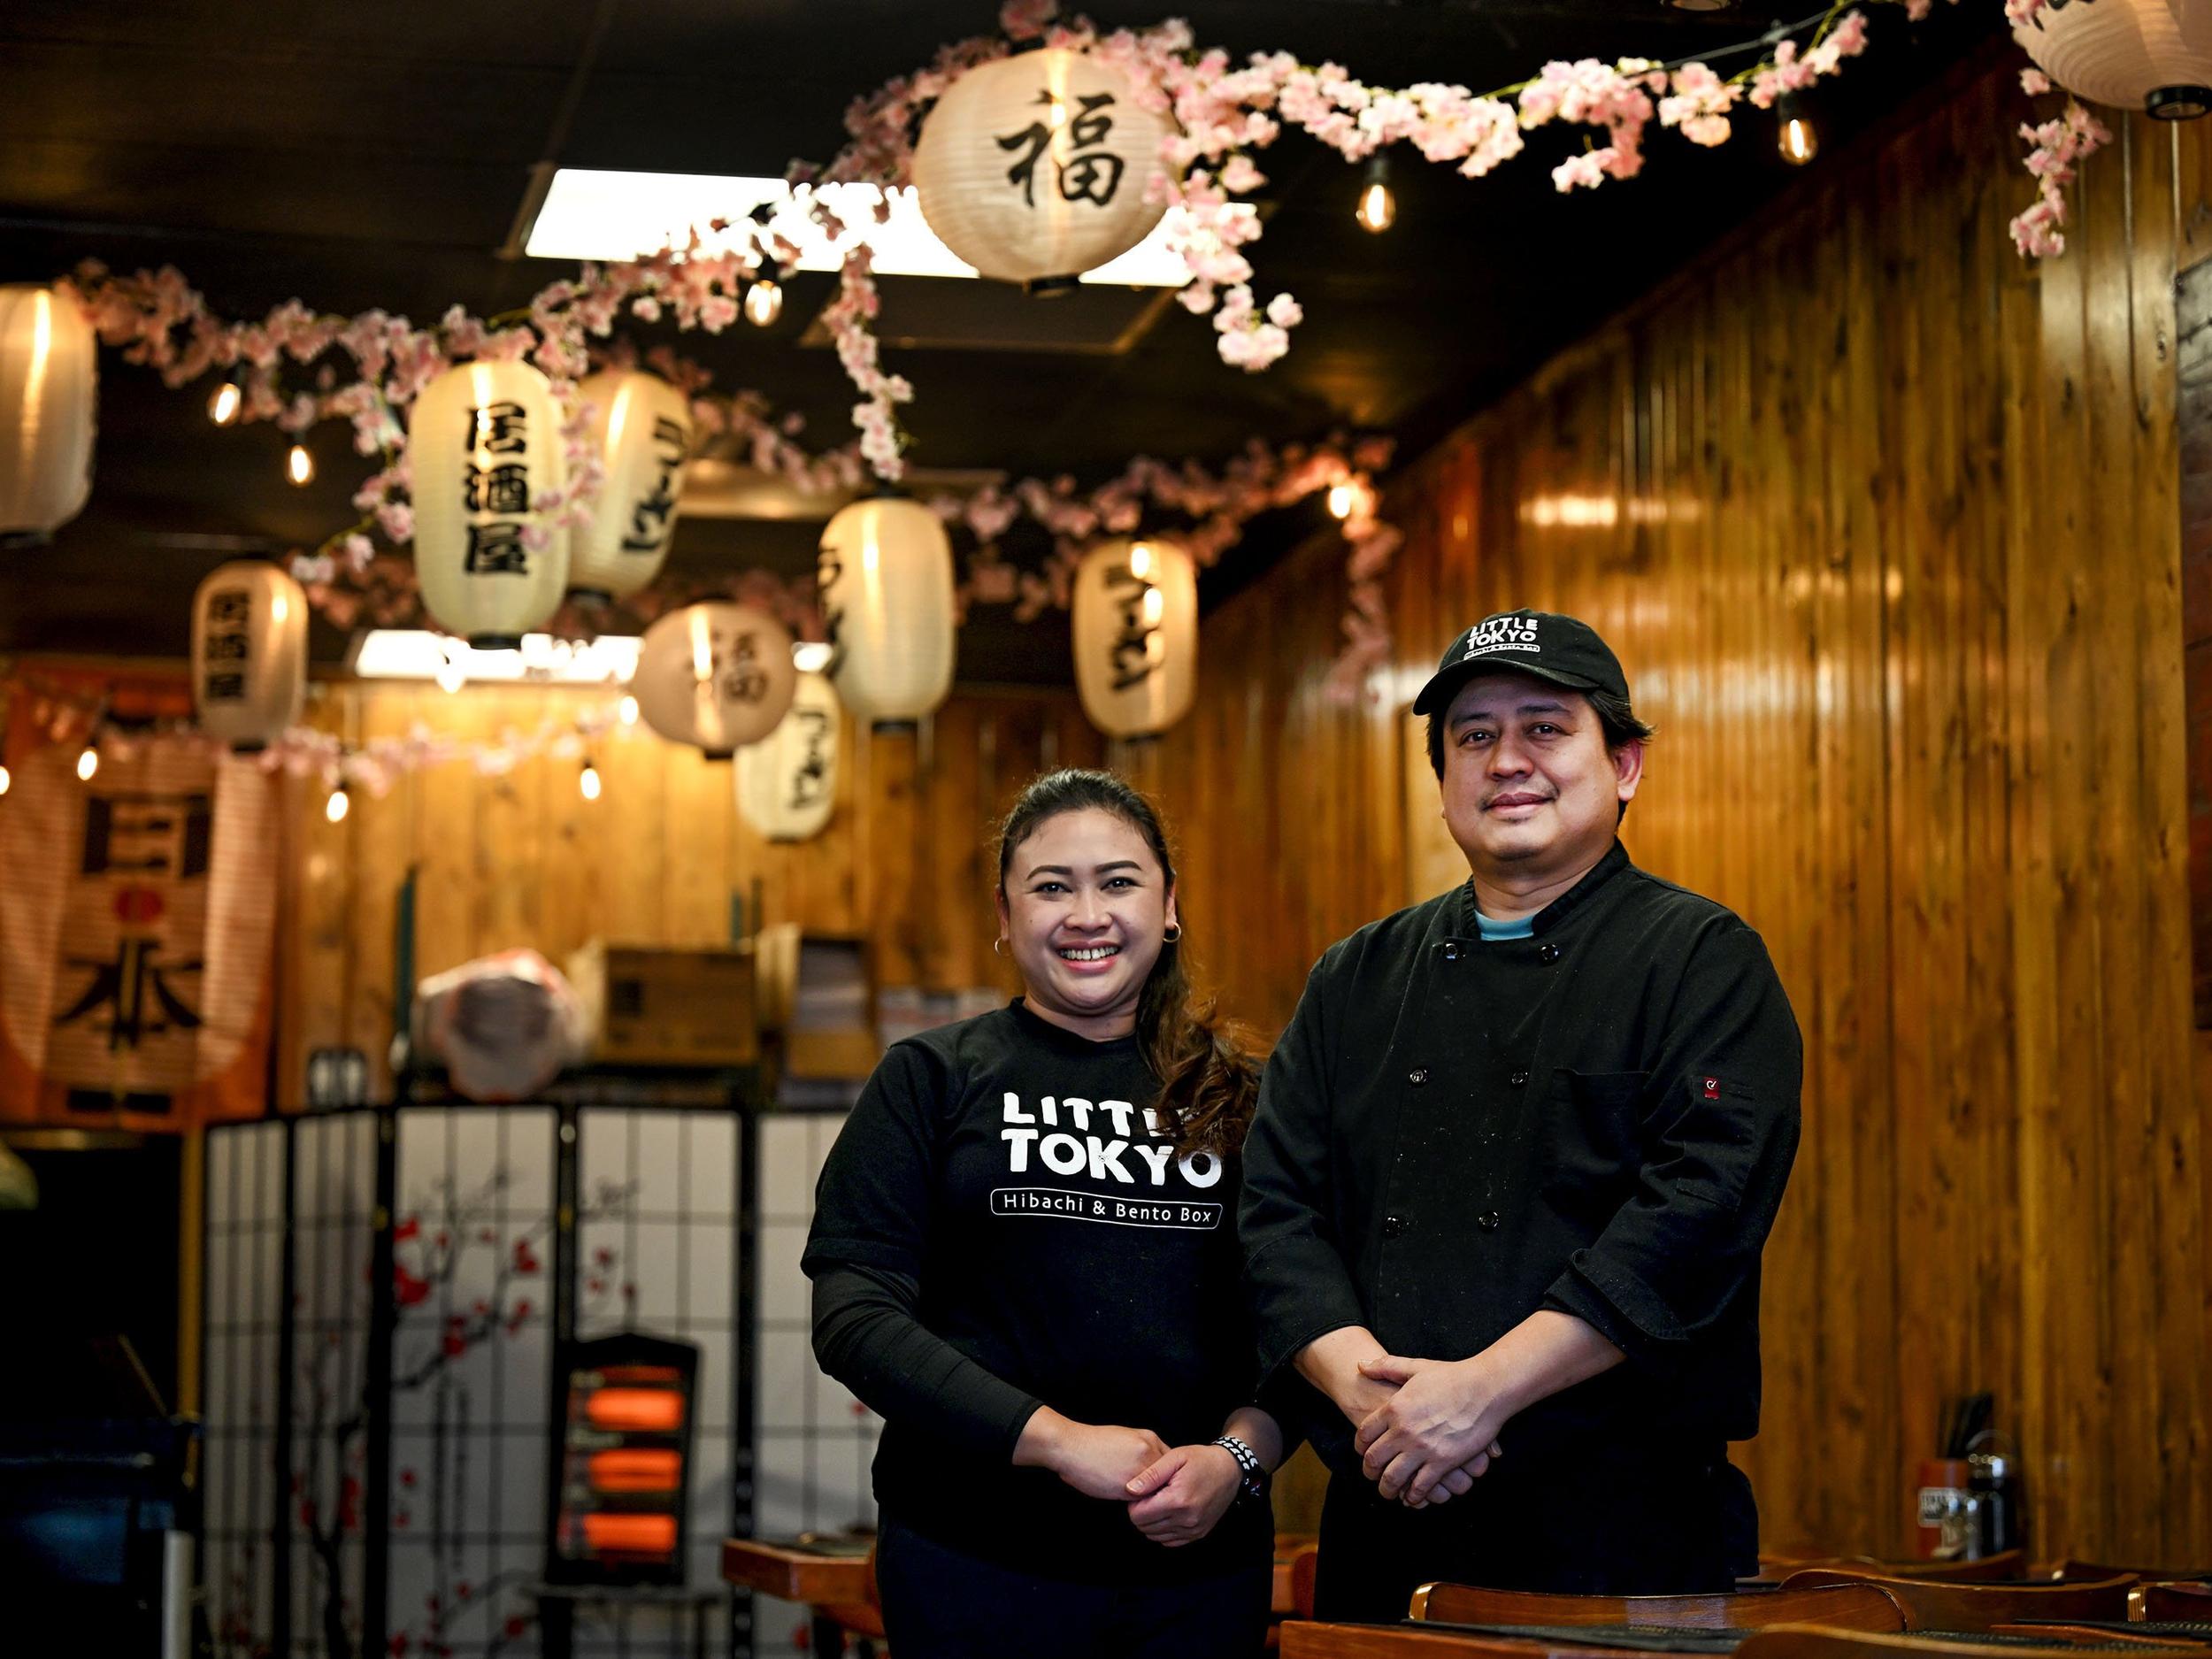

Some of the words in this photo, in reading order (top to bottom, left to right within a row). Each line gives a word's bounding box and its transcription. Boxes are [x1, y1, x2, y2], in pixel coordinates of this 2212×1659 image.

[995, 89, 1125, 208] 福
[465, 402, 528, 575] 居酒屋
[1467, 629, 1536, 649] TOKYO
[1470, 617, 1538, 638] LITTLE
[1001, 1128, 1222, 1188] TOKYO
[1004, 1193, 1083, 1212] Hibachi
[1093, 1201, 1106, 1216] &
[1117, 1203, 1171, 1221] Bento
[1181, 1208, 1211, 1223] Box
